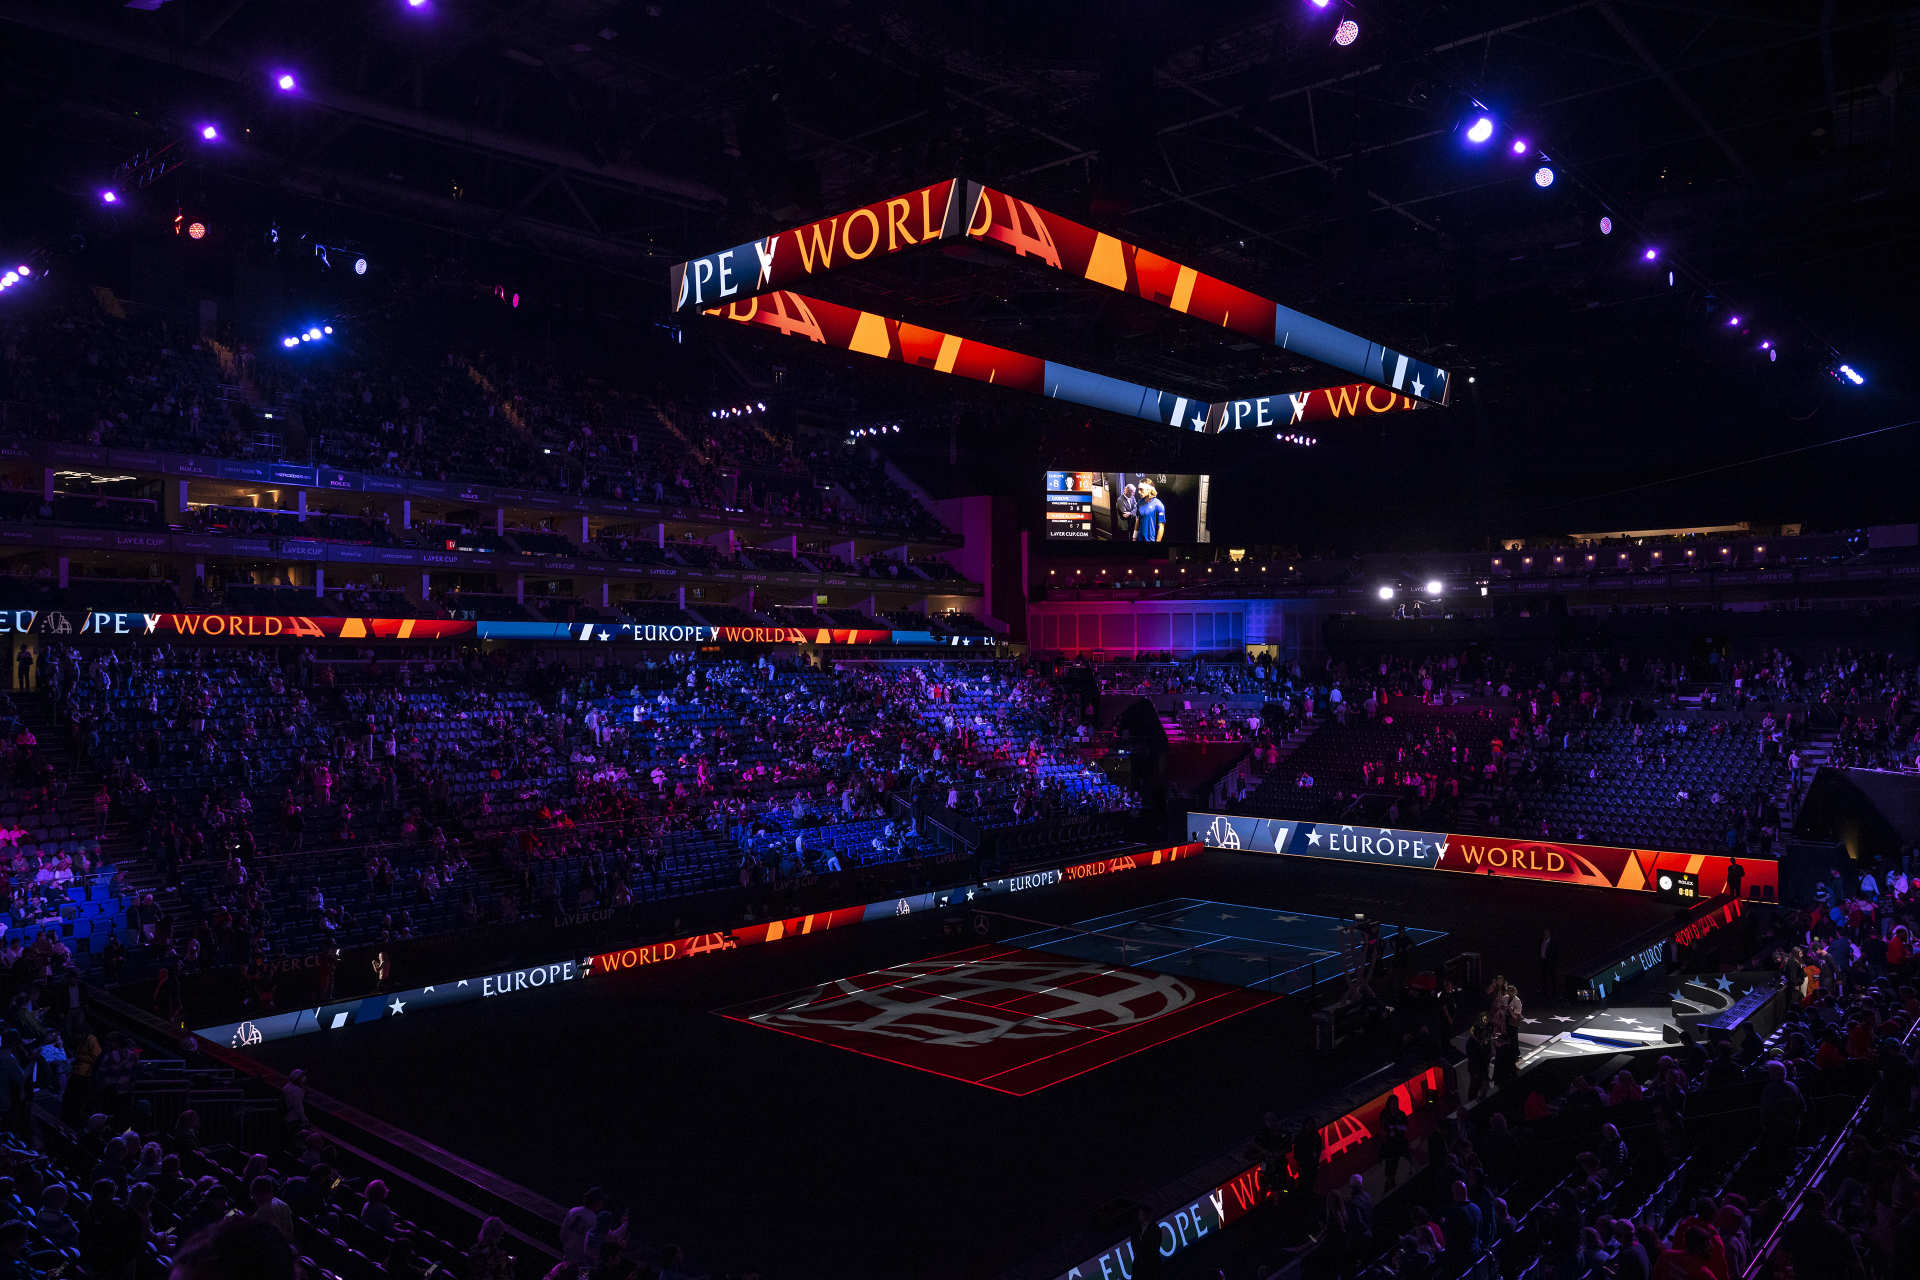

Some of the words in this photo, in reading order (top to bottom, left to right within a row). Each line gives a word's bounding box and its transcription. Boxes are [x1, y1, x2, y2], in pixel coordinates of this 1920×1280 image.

[172, 614, 283, 636] WORLD
[634, 625, 704, 642] EUROPE
[725, 627, 786, 642] WORLD
[1329, 833, 1425, 859] EUROPE
[1461, 844, 1565, 872] WORLD
[1010, 871, 1054, 892] EUROPE
[1067, 862, 1106, 880] WORLD
[482, 961, 574, 998] EUROPE
[601, 943, 677, 973] WORLD
